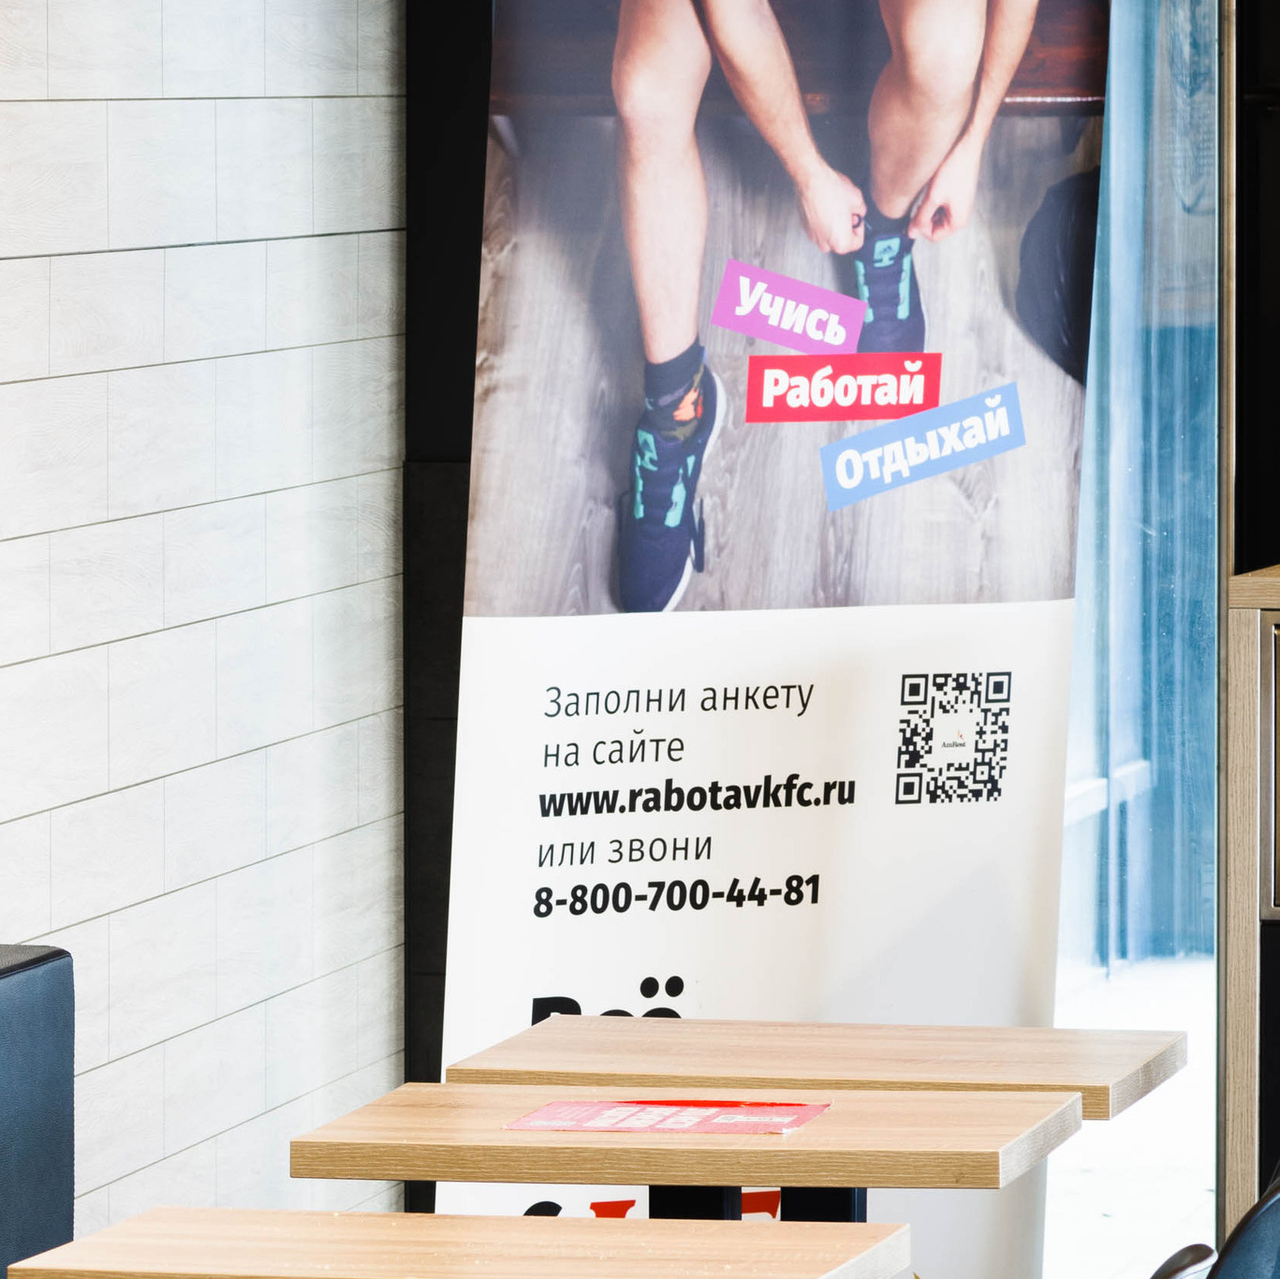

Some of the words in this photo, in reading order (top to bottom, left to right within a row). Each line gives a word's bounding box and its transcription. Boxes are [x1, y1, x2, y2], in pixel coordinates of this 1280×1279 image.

[735, 276, 847, 346] Учись
[762, 360, 926, 408] Работай
[835, 394, 1011, 489] Отдыхай
[543, 685, 687, 718] Заполни
[700, 682, 816, 718] анкету
[543, 741, 581, 768] на
[591, 728, 686, 765] сайте
[538, 773, 857, 819] www.rabotavkfc.ru
[537, 841, 596, 869] или
[606, 835, 713, 864] звони
[532, 873, 821, 919] 8-800-700-44-81
